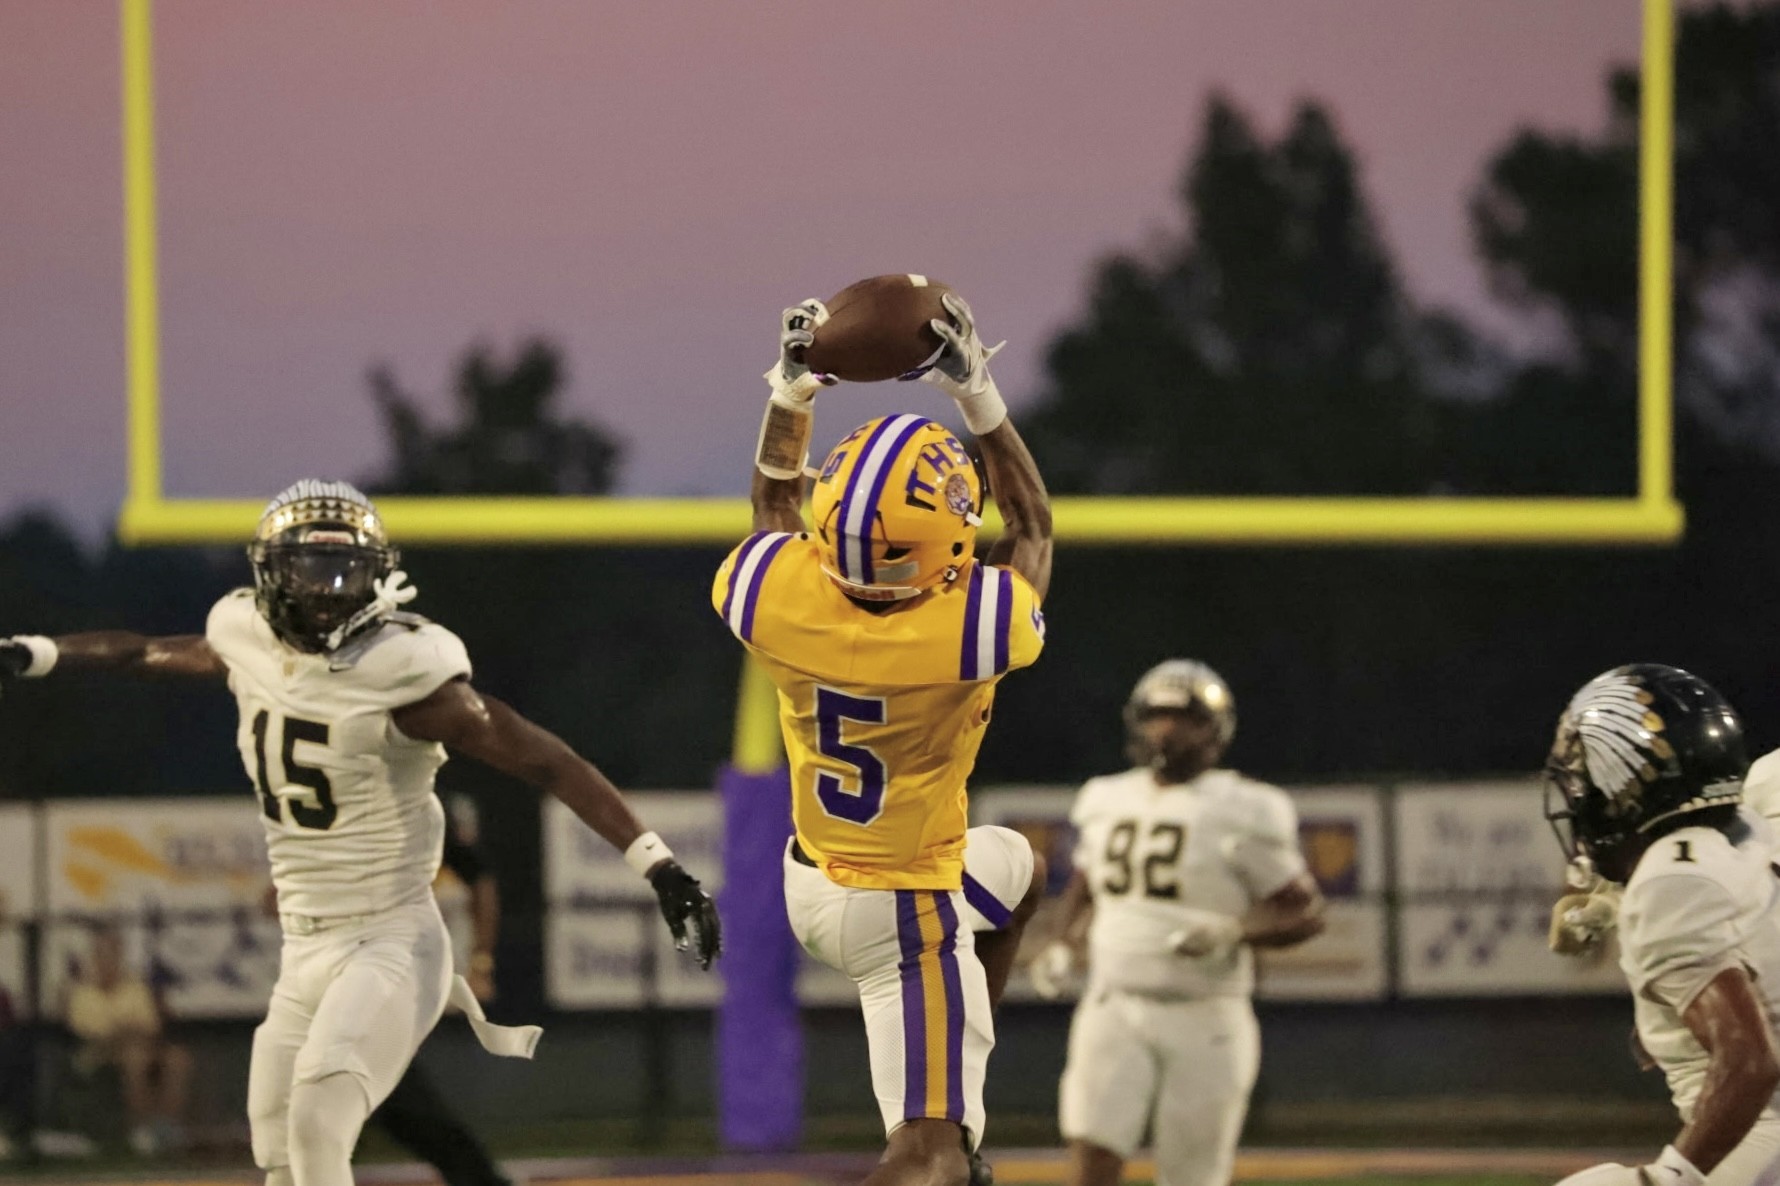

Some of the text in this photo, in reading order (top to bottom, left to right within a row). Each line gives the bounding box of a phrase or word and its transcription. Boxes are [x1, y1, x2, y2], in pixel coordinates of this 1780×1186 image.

[252, 708, 338, 831] 15
[812, 683, 888, 828] 5
[1104, 820, 1185, 898] 92
[1672, 840, 1697, 863] 1
